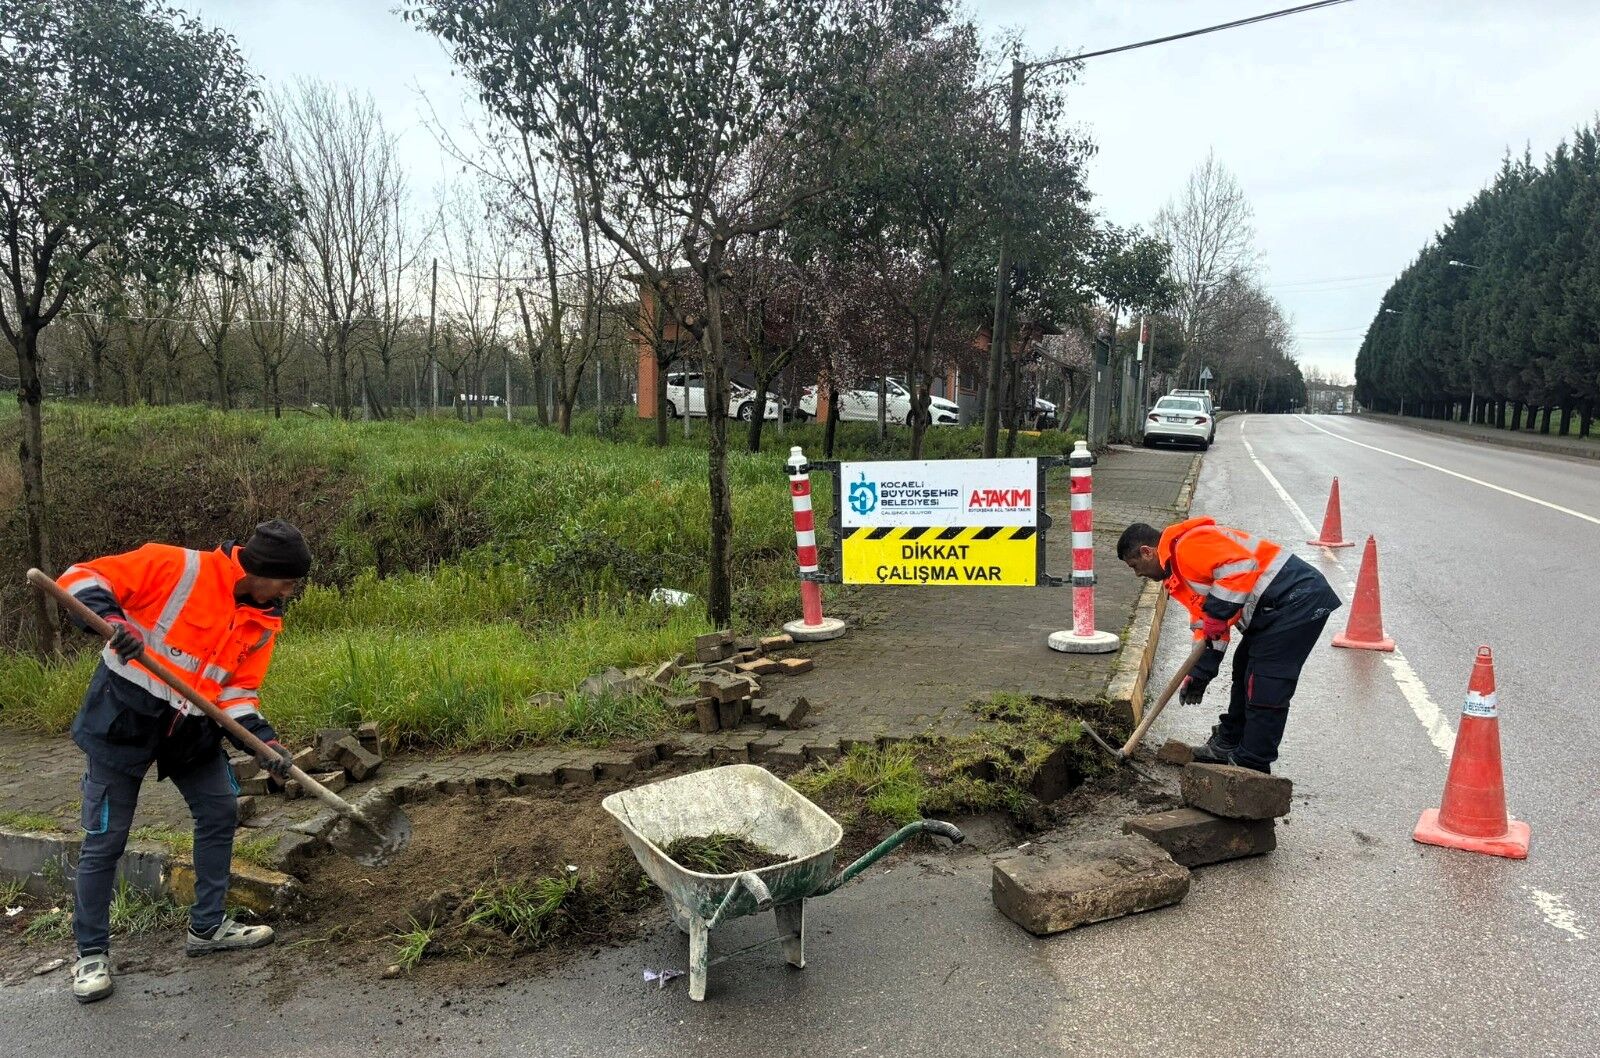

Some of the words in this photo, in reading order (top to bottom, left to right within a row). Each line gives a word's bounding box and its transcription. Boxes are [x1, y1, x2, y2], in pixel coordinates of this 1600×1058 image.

[880, 489, 959, 498] BÜYÜKŞEHİR
[969, 489, 1031, 507] A-TAKIMI
[902, 542, 970, 559] DİKKAT
[876, 566, 959, 583] ÇALIŞMA
[963, 566, 1002, 581] VAR
